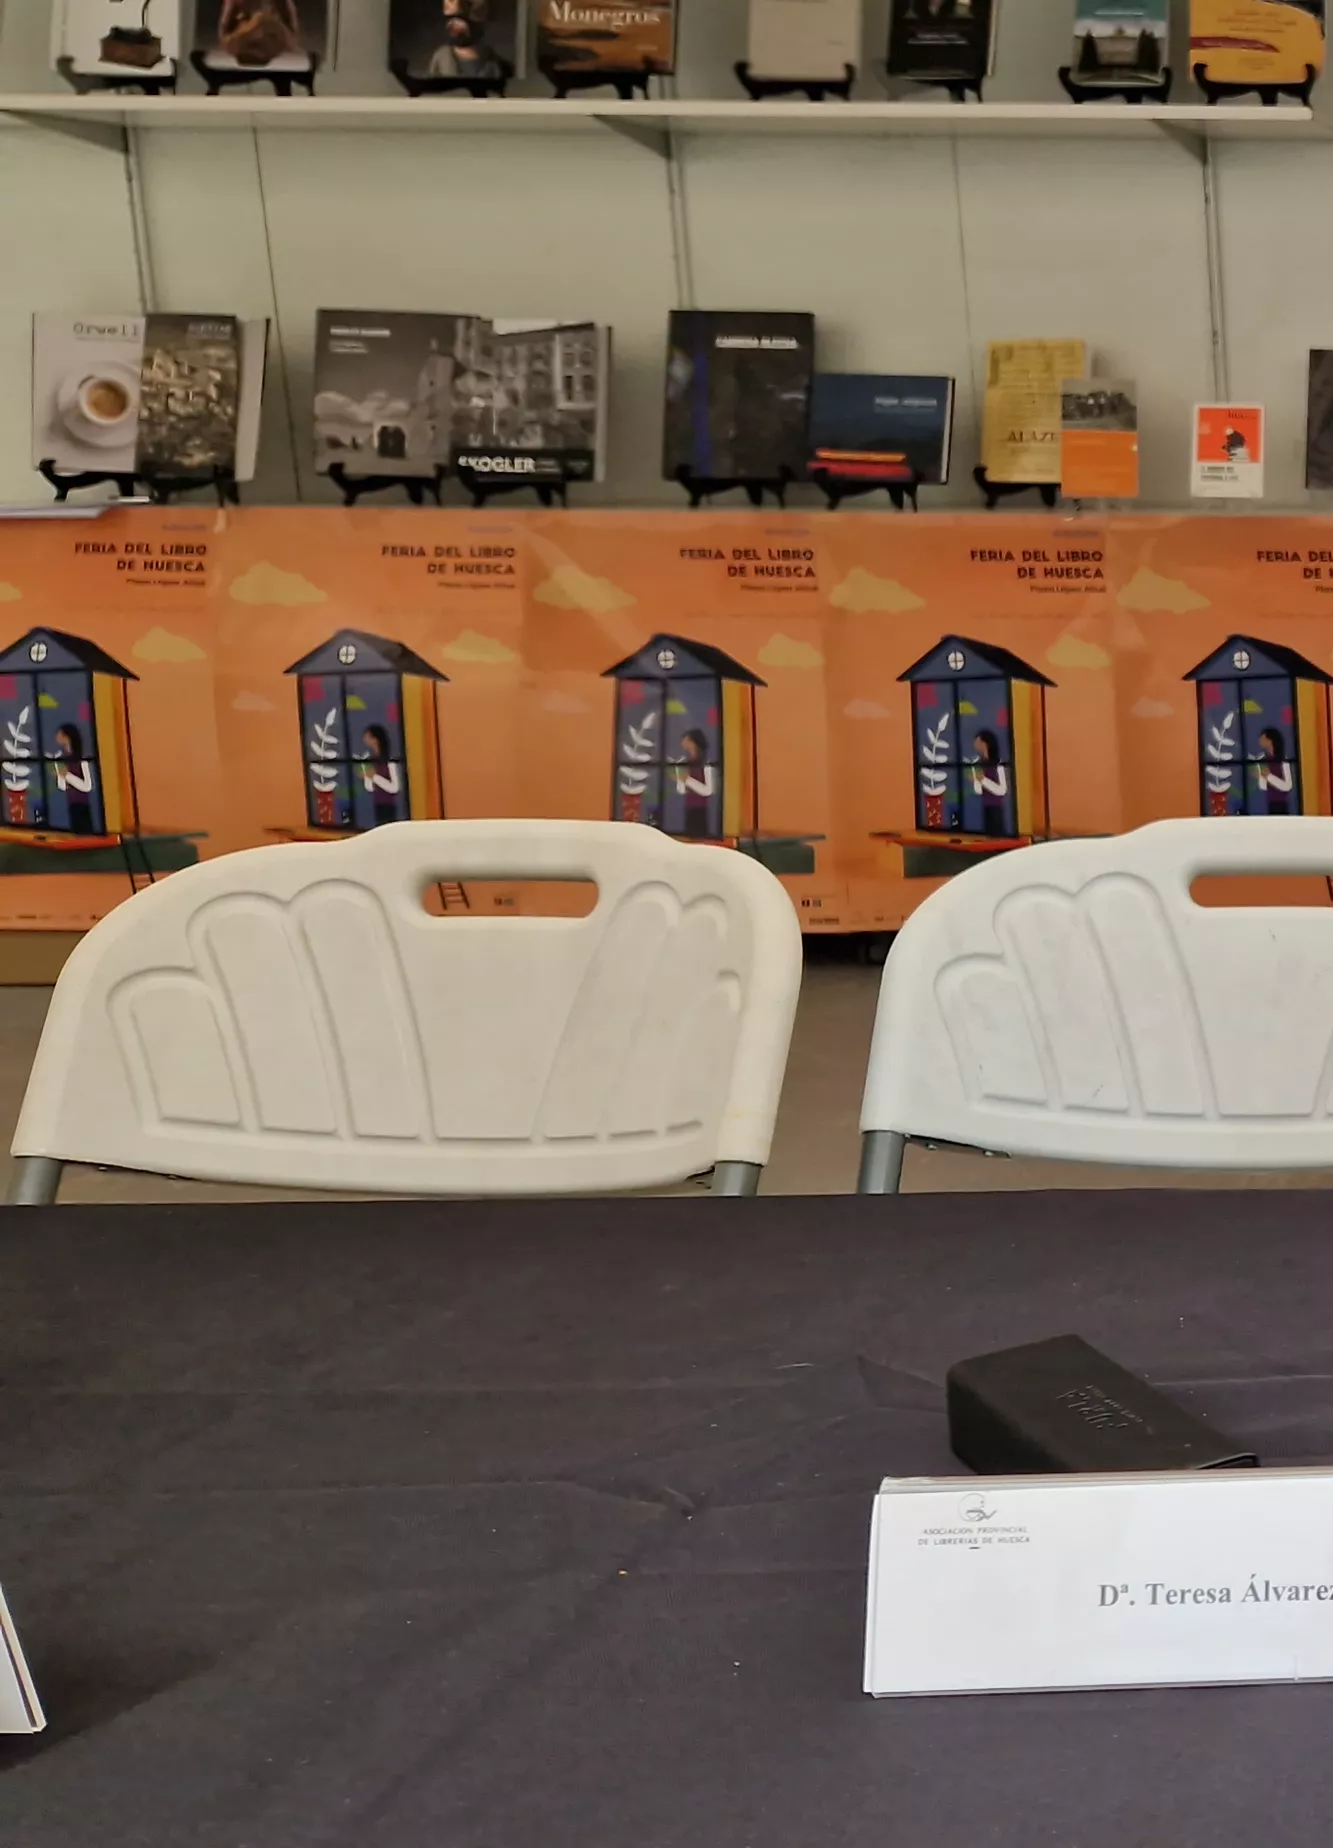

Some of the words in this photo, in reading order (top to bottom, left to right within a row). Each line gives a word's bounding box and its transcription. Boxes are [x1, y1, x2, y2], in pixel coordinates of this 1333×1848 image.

[549, 1, 661, 28] Monegros
[73, 321, 140, 337] Orwell
[970, 549, 1016, 562] FERIA
[1021, 550, 1051, 562] DEL
[1056, 550, 1104, 563] LIBRO
[1256, 550, 1302, 563] FERIA
[1016, 567, 1037, 579] DE
[1043, 567, 1104, 579] HUESCA
[1303, 567, 1322, 579] DE
[976, 1526, 1028, 1535] PROVINCIAL
[917, 1538, 929, 1546] DE
[981, 1537, 993, 1545] DE
[997, 1536, 1031, 1544] HUESCA
[1144, 1581, 1232, 1607] Teresa
